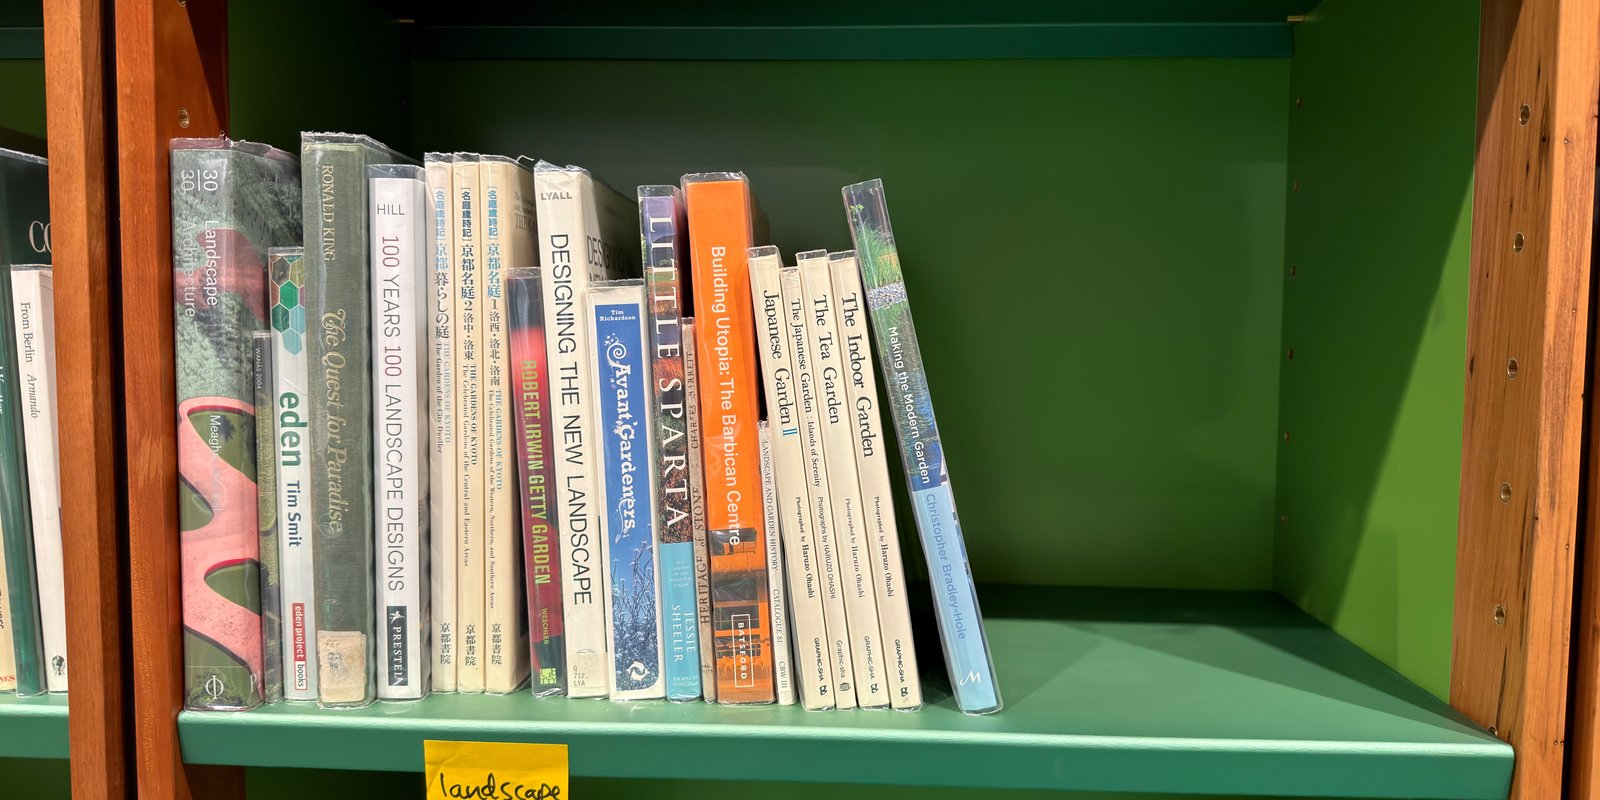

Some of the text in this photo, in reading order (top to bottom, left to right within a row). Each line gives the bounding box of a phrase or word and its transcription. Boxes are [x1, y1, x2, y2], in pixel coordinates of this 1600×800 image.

[322, 165, 336, 261] RONALD KING
[377, 204, 405, 216] HILL
[540, 192, 572, 200] LYALL
[180, 170, 196, 318] 30 Architecture
[203, 170, 220, 306] 30 Landscape
[650, 217, 680, 358] LITTLE
[791, 298, 802, 321] The
[21, 302, 39, 418] From Berlin Armando
[764, 290, 798, 436] Japanese Garden II
[791, 323, 806, 370] Japanese
[814, 294, 842, 424] The Tea Garden
[842, 292, 876, 458] The Indoor Garden
[322, 308, 349, 532] The Quest for Paradise
[382, 236, 404, 592] 100 YEARS 100 LANDSCAPE DESIGNS
[550, 234, 592, 605] DESIGNING THE NEW LANDSCAPE
[711, 246, 742, 546] Building Utopia: The Barbican Centre
[800, 372, 814, 414] Garden
[888, 326, 930, 484] Making the Modern Garden
[280, 391, 308, 467] eden
[471, 423, 478, 434] OF
[496, 448, 502, 459] OF
[658, 378, 690, 528] SPARTA
[806, 421, 816, 448] Islands
[521, 360, 551, 584] ROBERT IRWIN GETTY GARDEN
[762, 440, 772, 485] LANDSCAPE
[812, 458, 820, 488] Serenity
[287, 480, 302, 547] Tim Smit
[766, 506, 776, 537] GARDEN
[692, 487, 710, 624] HERITAGE of STONE
[769, 538, 778, 571] HISTORY
[796, 496, 816, 598] Photographed Haruzo Ohashi
[817, 496, 828, 534] Photographs
[824, 544, 832, 572] HARUZO
[828, 574, 836, 599] OHASHI
[846, 498, 865, 598] Photographed Haruzo Ohashi
[874, 496, 894, 597] Photographed Haruzo Ohashi
[926, 494, 966, 640] Christopher Bradley-Hole
[295, 606, 304, 658] eden project
[541, 608, 550, 645] WESCHLER
[672, 605, 684, 662] SHEELER
[684, 612, 696, 653] JESSIE
[773, 589, 782, 634] CATALOGUE
[297, 664, 305, 687] books
[394, 626, 403, 678] PRESTEL
[736, 622, 748, 680] BATSFORD
[814, 637, 824, 682] GRAPHIC-SHA
[836, 640, 846, 678] Graphic-sha
[864, 636, 875, 680] GRAPHIC-SHA
[894, 639, 906, 683] GRAPHIC-SHA
[440, 772, 561, 800] landscape
